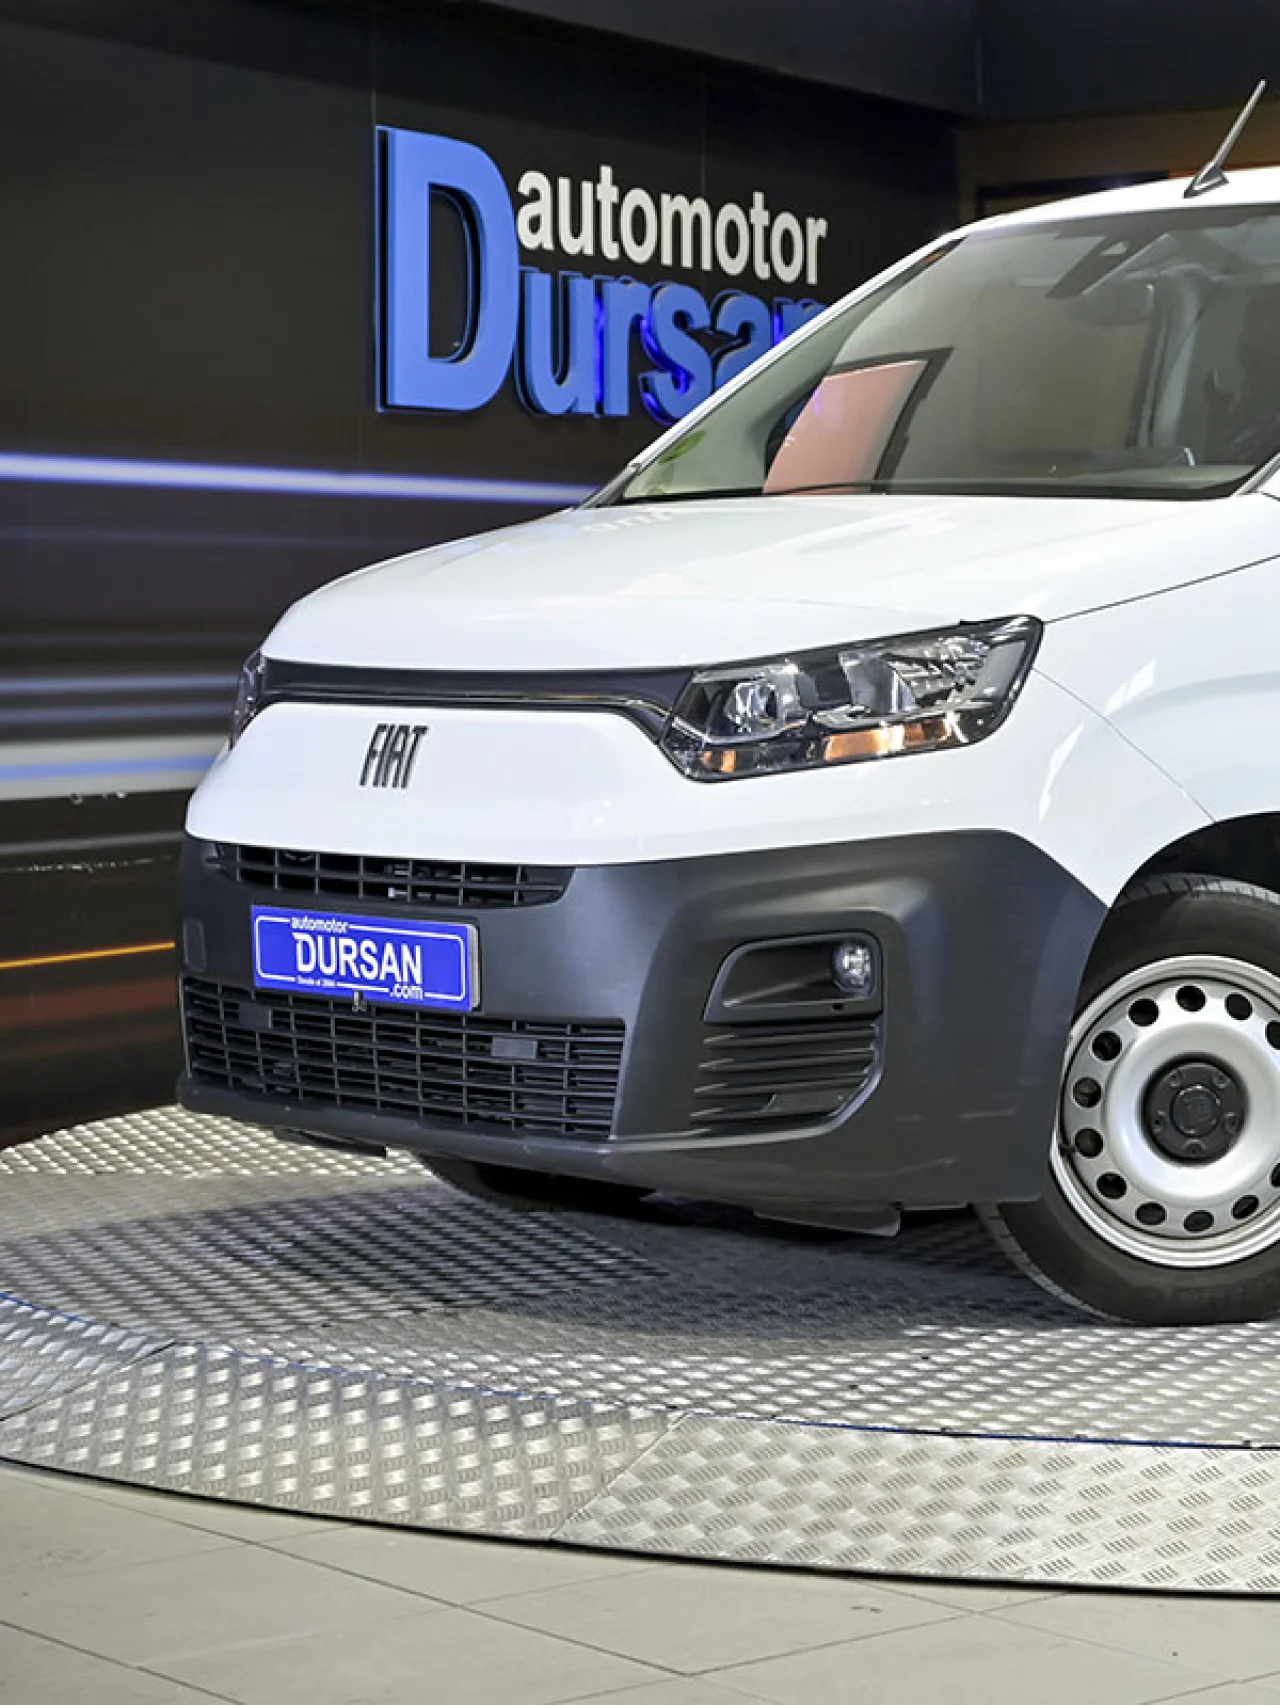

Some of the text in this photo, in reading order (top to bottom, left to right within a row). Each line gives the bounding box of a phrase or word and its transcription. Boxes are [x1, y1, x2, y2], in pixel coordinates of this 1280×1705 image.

[517, 165, 828, 286] automotor
[376, 125, 829, 426] Dursa
[359, 723, 430, 789] FIAT
[290, 915, 349, 933] automotor
[292, 931, 423, 985] DURSAN
[389, 982, 424, 1001] .com
